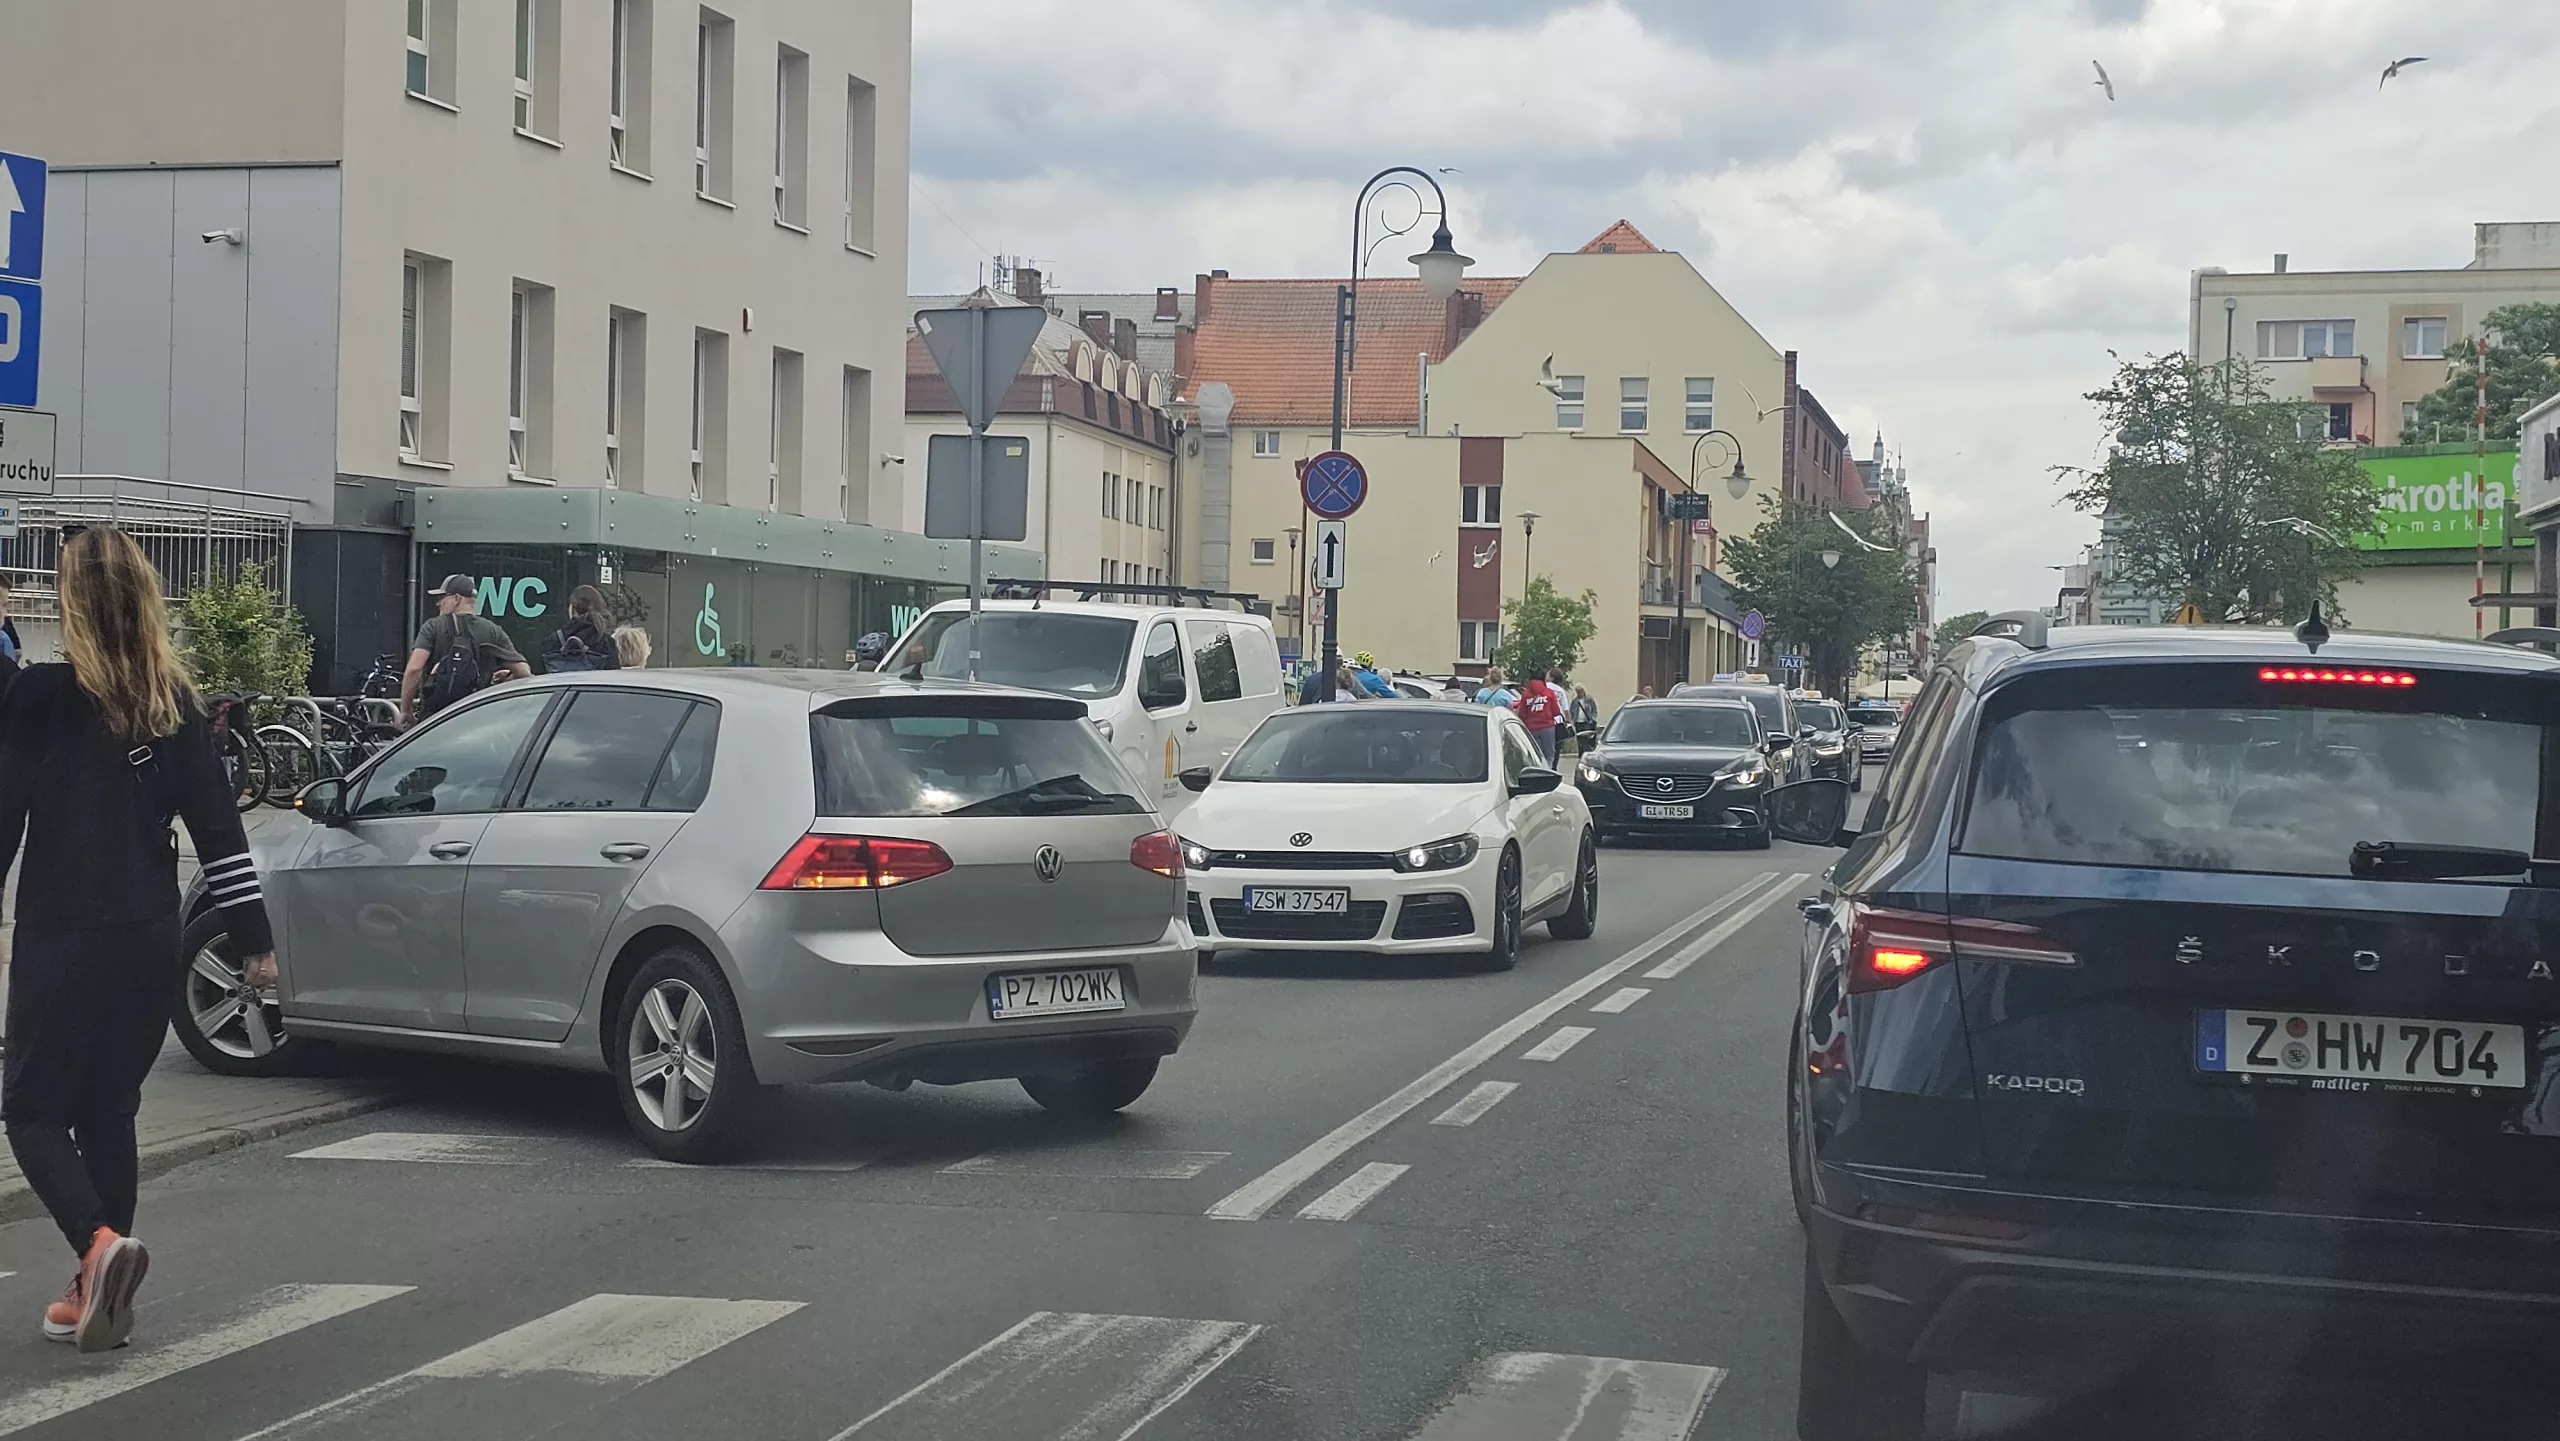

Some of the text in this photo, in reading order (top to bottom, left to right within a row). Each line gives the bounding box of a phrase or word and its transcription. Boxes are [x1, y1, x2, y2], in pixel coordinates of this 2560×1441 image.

[0, 458, 50, 481] ruchu
[471, 576, 548, 618] WC
[1780, 657, 1803, 669] TAXI
[1646, 807, 1657, 816] GI
[1254, 891, 1345, 911] ZSW 37547
[1006, 971, 1117, 1008] PZ 702WK
[2206, 1047, 2217, 1060] D
[2246, 1017, 2499, 1079] Z HW 704
[1988, 1074, 2084, 1096] KAROQ
